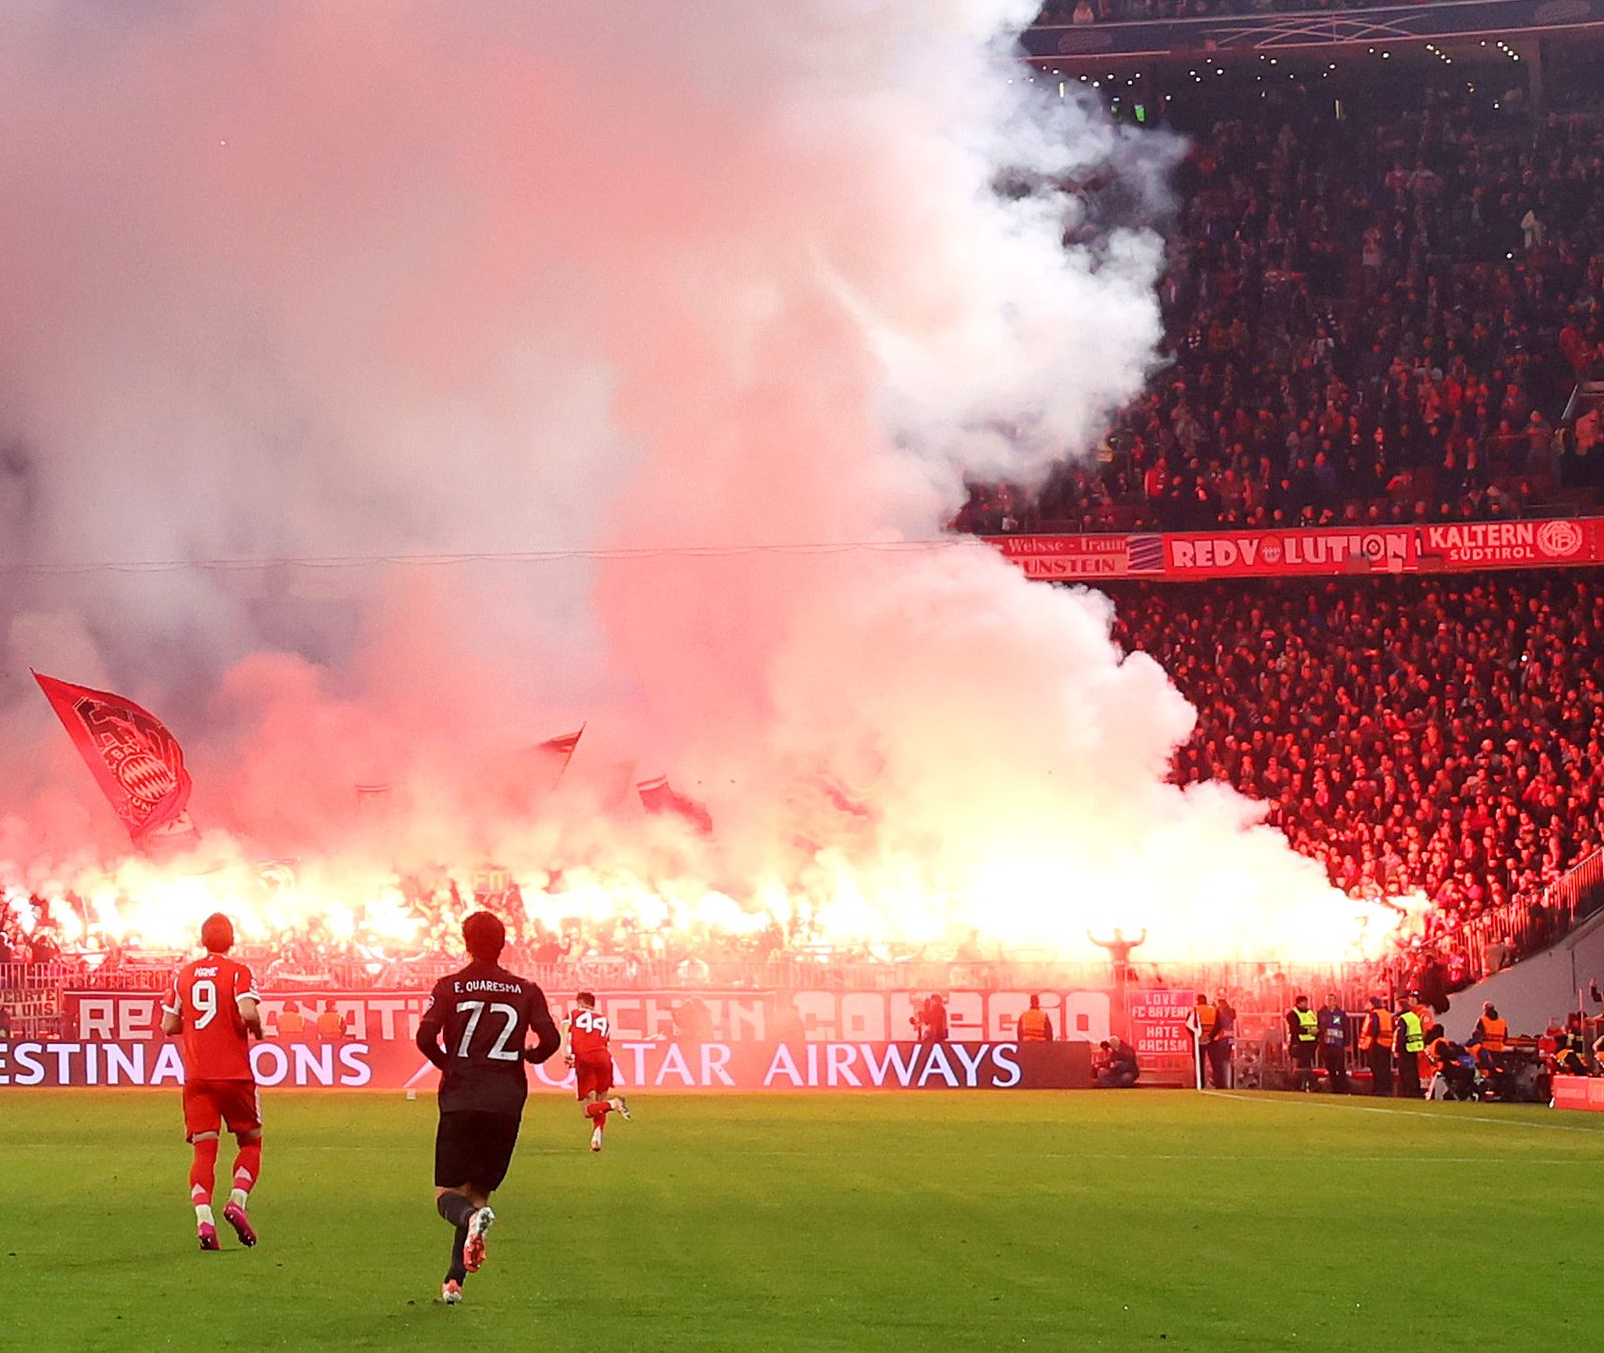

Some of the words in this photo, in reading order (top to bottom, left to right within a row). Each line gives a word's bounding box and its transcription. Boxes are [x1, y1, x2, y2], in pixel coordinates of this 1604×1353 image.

[1429, 523, 1534, 548] KALTERN
[1450, 547, 1535, 561] SÜDTIROL
[194, 966, 218, 977] KANE
[454, 982, 464, 994] E.
[466, 980, 522, 994] QUARESMA
[192, 980, 218, 1030] 9
[1146, 994, 1177, 1005] LOVE
[22, 1003, 55, 1016] UNS
[1132, 1006, 1145, 1017] FC
[1148, 1006, 1193, 1018] BAYERN
[456, 1000, 519, 1061] 72
[575, 1011, 608, 1037] 44
[1146, 1026, 1179, 1038] HATE
[1138, 1040, 1188, 1051] RACISM
[763, 1043, 1023, 1088] AIRWAYS
